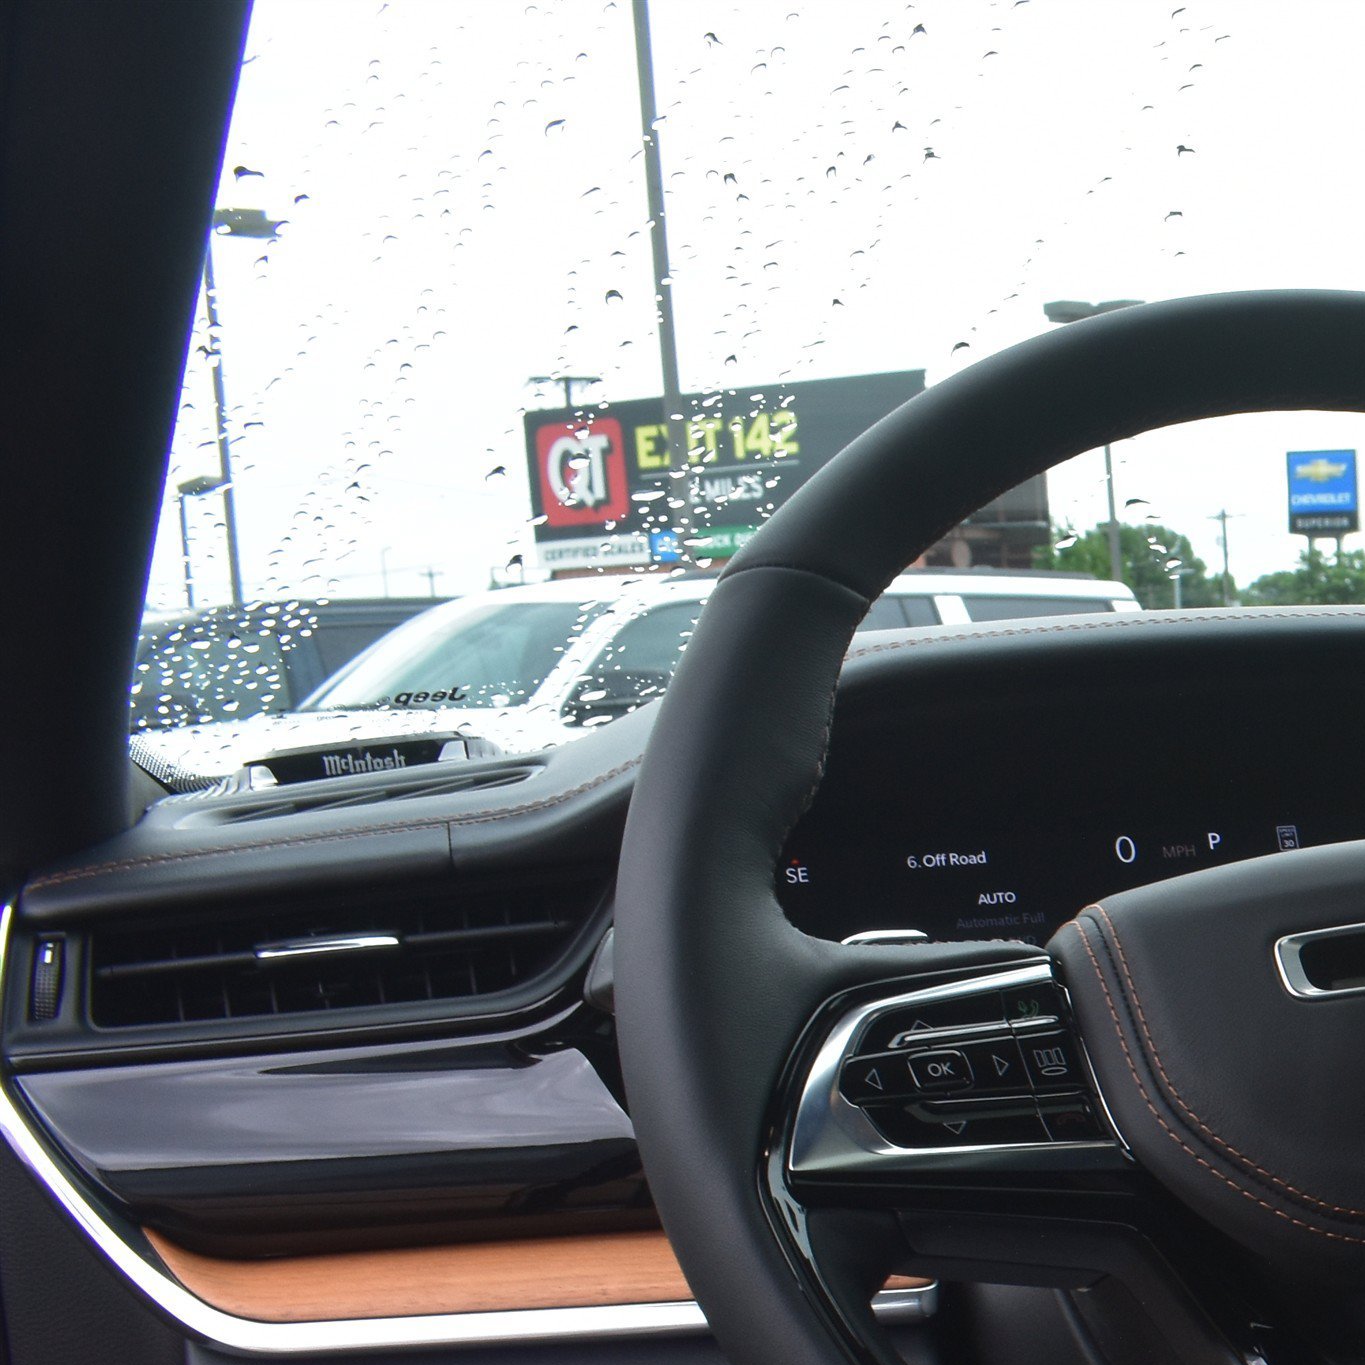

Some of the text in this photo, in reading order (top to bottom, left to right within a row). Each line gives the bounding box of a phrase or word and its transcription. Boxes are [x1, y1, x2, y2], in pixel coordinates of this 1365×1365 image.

[728, 409, 800, 462] 142
[705, 475, 764, 504] MILES
[322, 749, 406, 776] McIntosh
[1207, 832, 1221, 850] P
[922, 853, 946, 867] Off
[949, 850, 987, 866] Road
[1162, 844, 1196, 859] MPH
[785, 866, 810, 884] SE
[978, 891, 1017, 905] AUTO
[956, 912, 1046, 930] Automatic Full
[926, 1055, 955, 1078] OK
